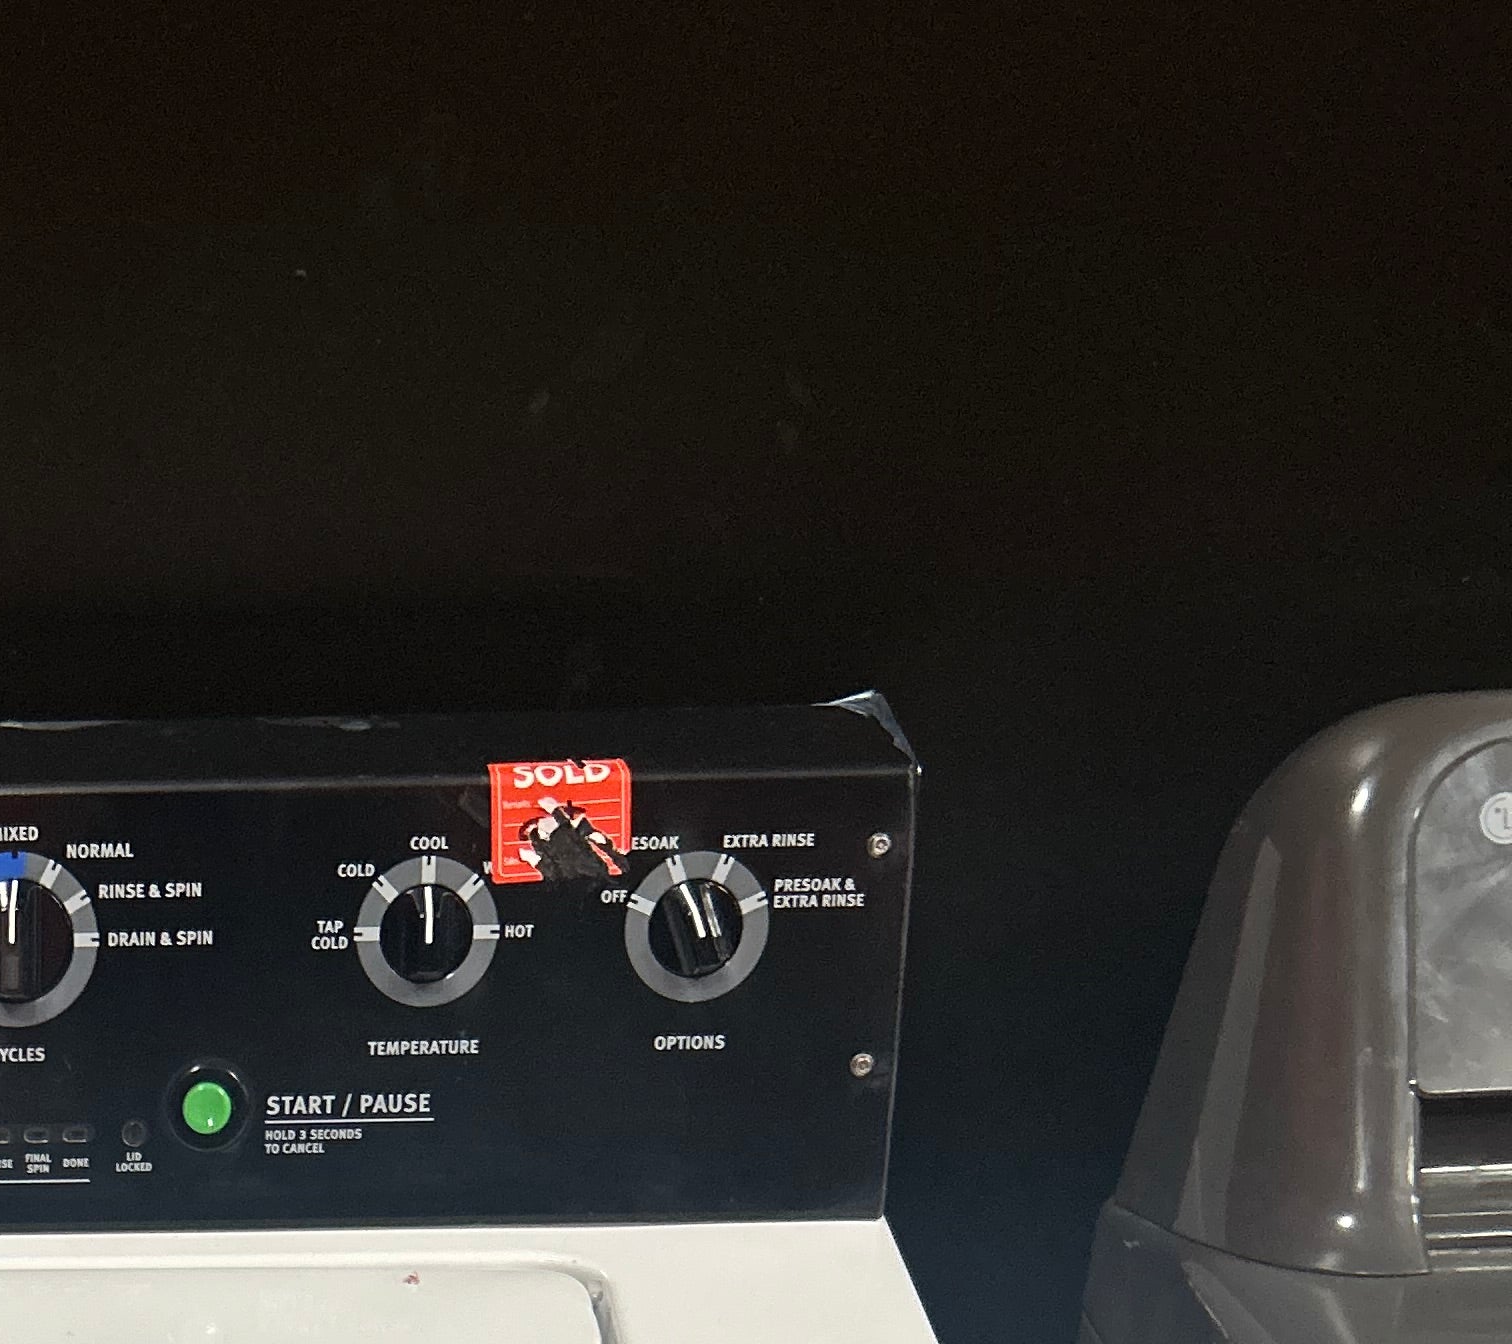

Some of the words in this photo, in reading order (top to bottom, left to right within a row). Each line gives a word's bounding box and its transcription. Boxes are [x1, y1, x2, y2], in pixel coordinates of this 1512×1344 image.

[513, 764, 611, 788] SOLD
[409, 835, 449, 851] COOL
[631, 835, 680, 851] ESOAK
[723, 833, 769, 849] EXTRA
[771, 832, 815, 847] RINSE
[66, 842, 135, 859] NORMAL
[337, 863, 376, 878] COLD
[98, 883, 146, 899] RINSE
[148, 883, 162, 898] &
[164, 882, 202, 898] SPIN
[773, 877, 842, 893] PRESOAK
[843, 877, 857, 891] &
[600, 889, 630, 906] OFF
[773, 894, 819, 909] EXTRA
[821, 893, 866, 908] RINSE
[316, 920, 344, 934] TAP
[504, 924, 535, 938] HOT
[107, 931, 156, 947] DRAIN
[159, 931, 173, 946] &
[176, 930, 214, 946] SPIN
[310, 935, 349, 950] COLD
[367, 1039, 480, 1056] TEMPERATURE
[653, 1034, 726, 1051] OPTIONS
[266, 1094, 336, 1116] START
[341, 1093, 353, 1118] /
[359, 1093, 431, 1114] PAUSE
[264, 1129, 297, 1141] HOLD
[298, 1129, 307, 1141] 3
[309, 1128, 363, 1141] SECONDS
[126, 1151, 143, 1162] LID
[263, 1143, 280, 1155] TO
[282, 1142, 326, 1154] CANCEL
[24, 1153, 53, 1163] FINAL
[62, 1157, 90, 1168] DONE
[26, 1163, 50, 1174] SPIN
[115, 1161, 153, 1173] LOCKED
